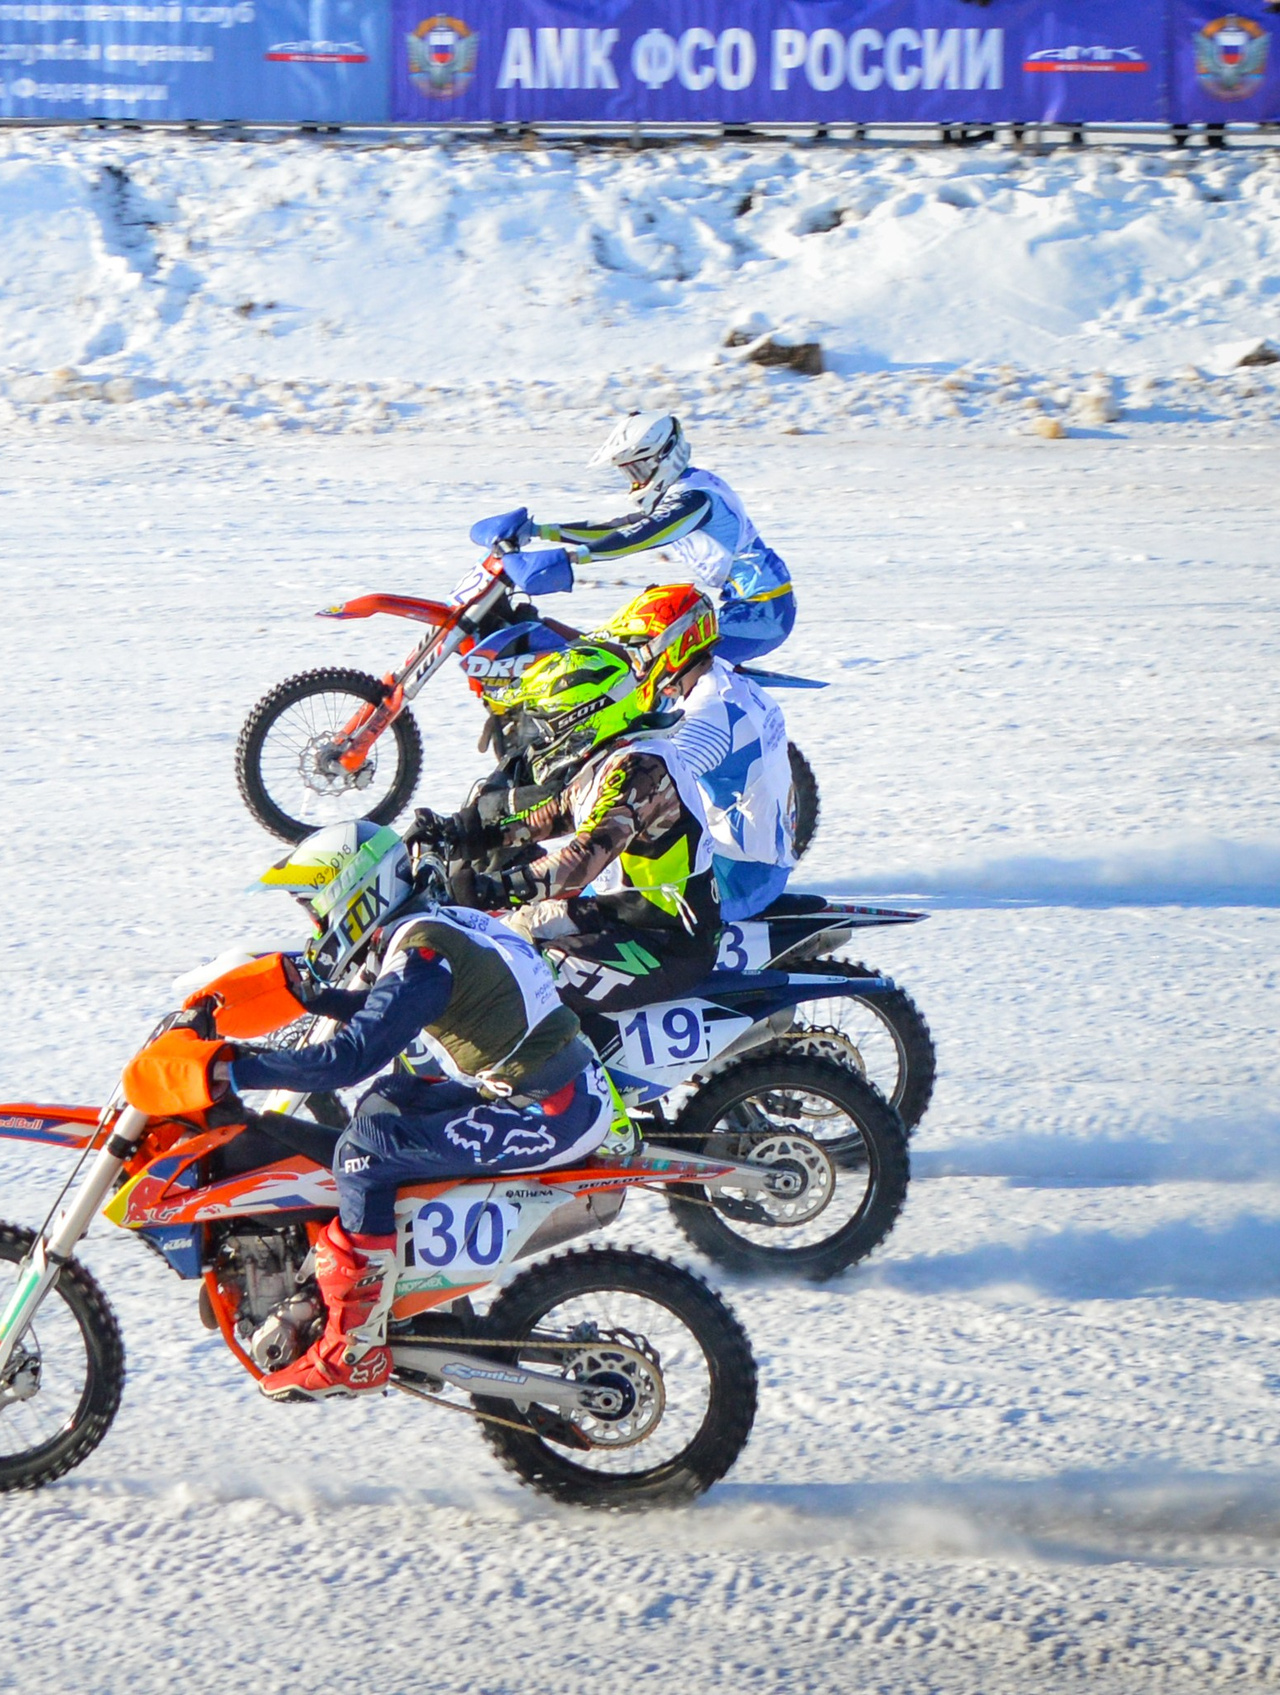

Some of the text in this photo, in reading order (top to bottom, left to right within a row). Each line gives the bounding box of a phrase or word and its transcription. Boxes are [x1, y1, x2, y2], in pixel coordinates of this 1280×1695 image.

[496, 27, 1005, 91] АМК ФСО РОССИИ
[557, 696, 607, 730] SCOTT
[338, 873, 391, 947] FOX
[624, 1006, 701, 1066] 19
[16, 1117, 44, 1131] Bull
[344, 1155, 371, 1174] FOX
[514, 1189, 553, 1199] ATHENA
[577, 1176, 646, 1190] DUNLOP
[416, 1201, 504, 1267] 30
